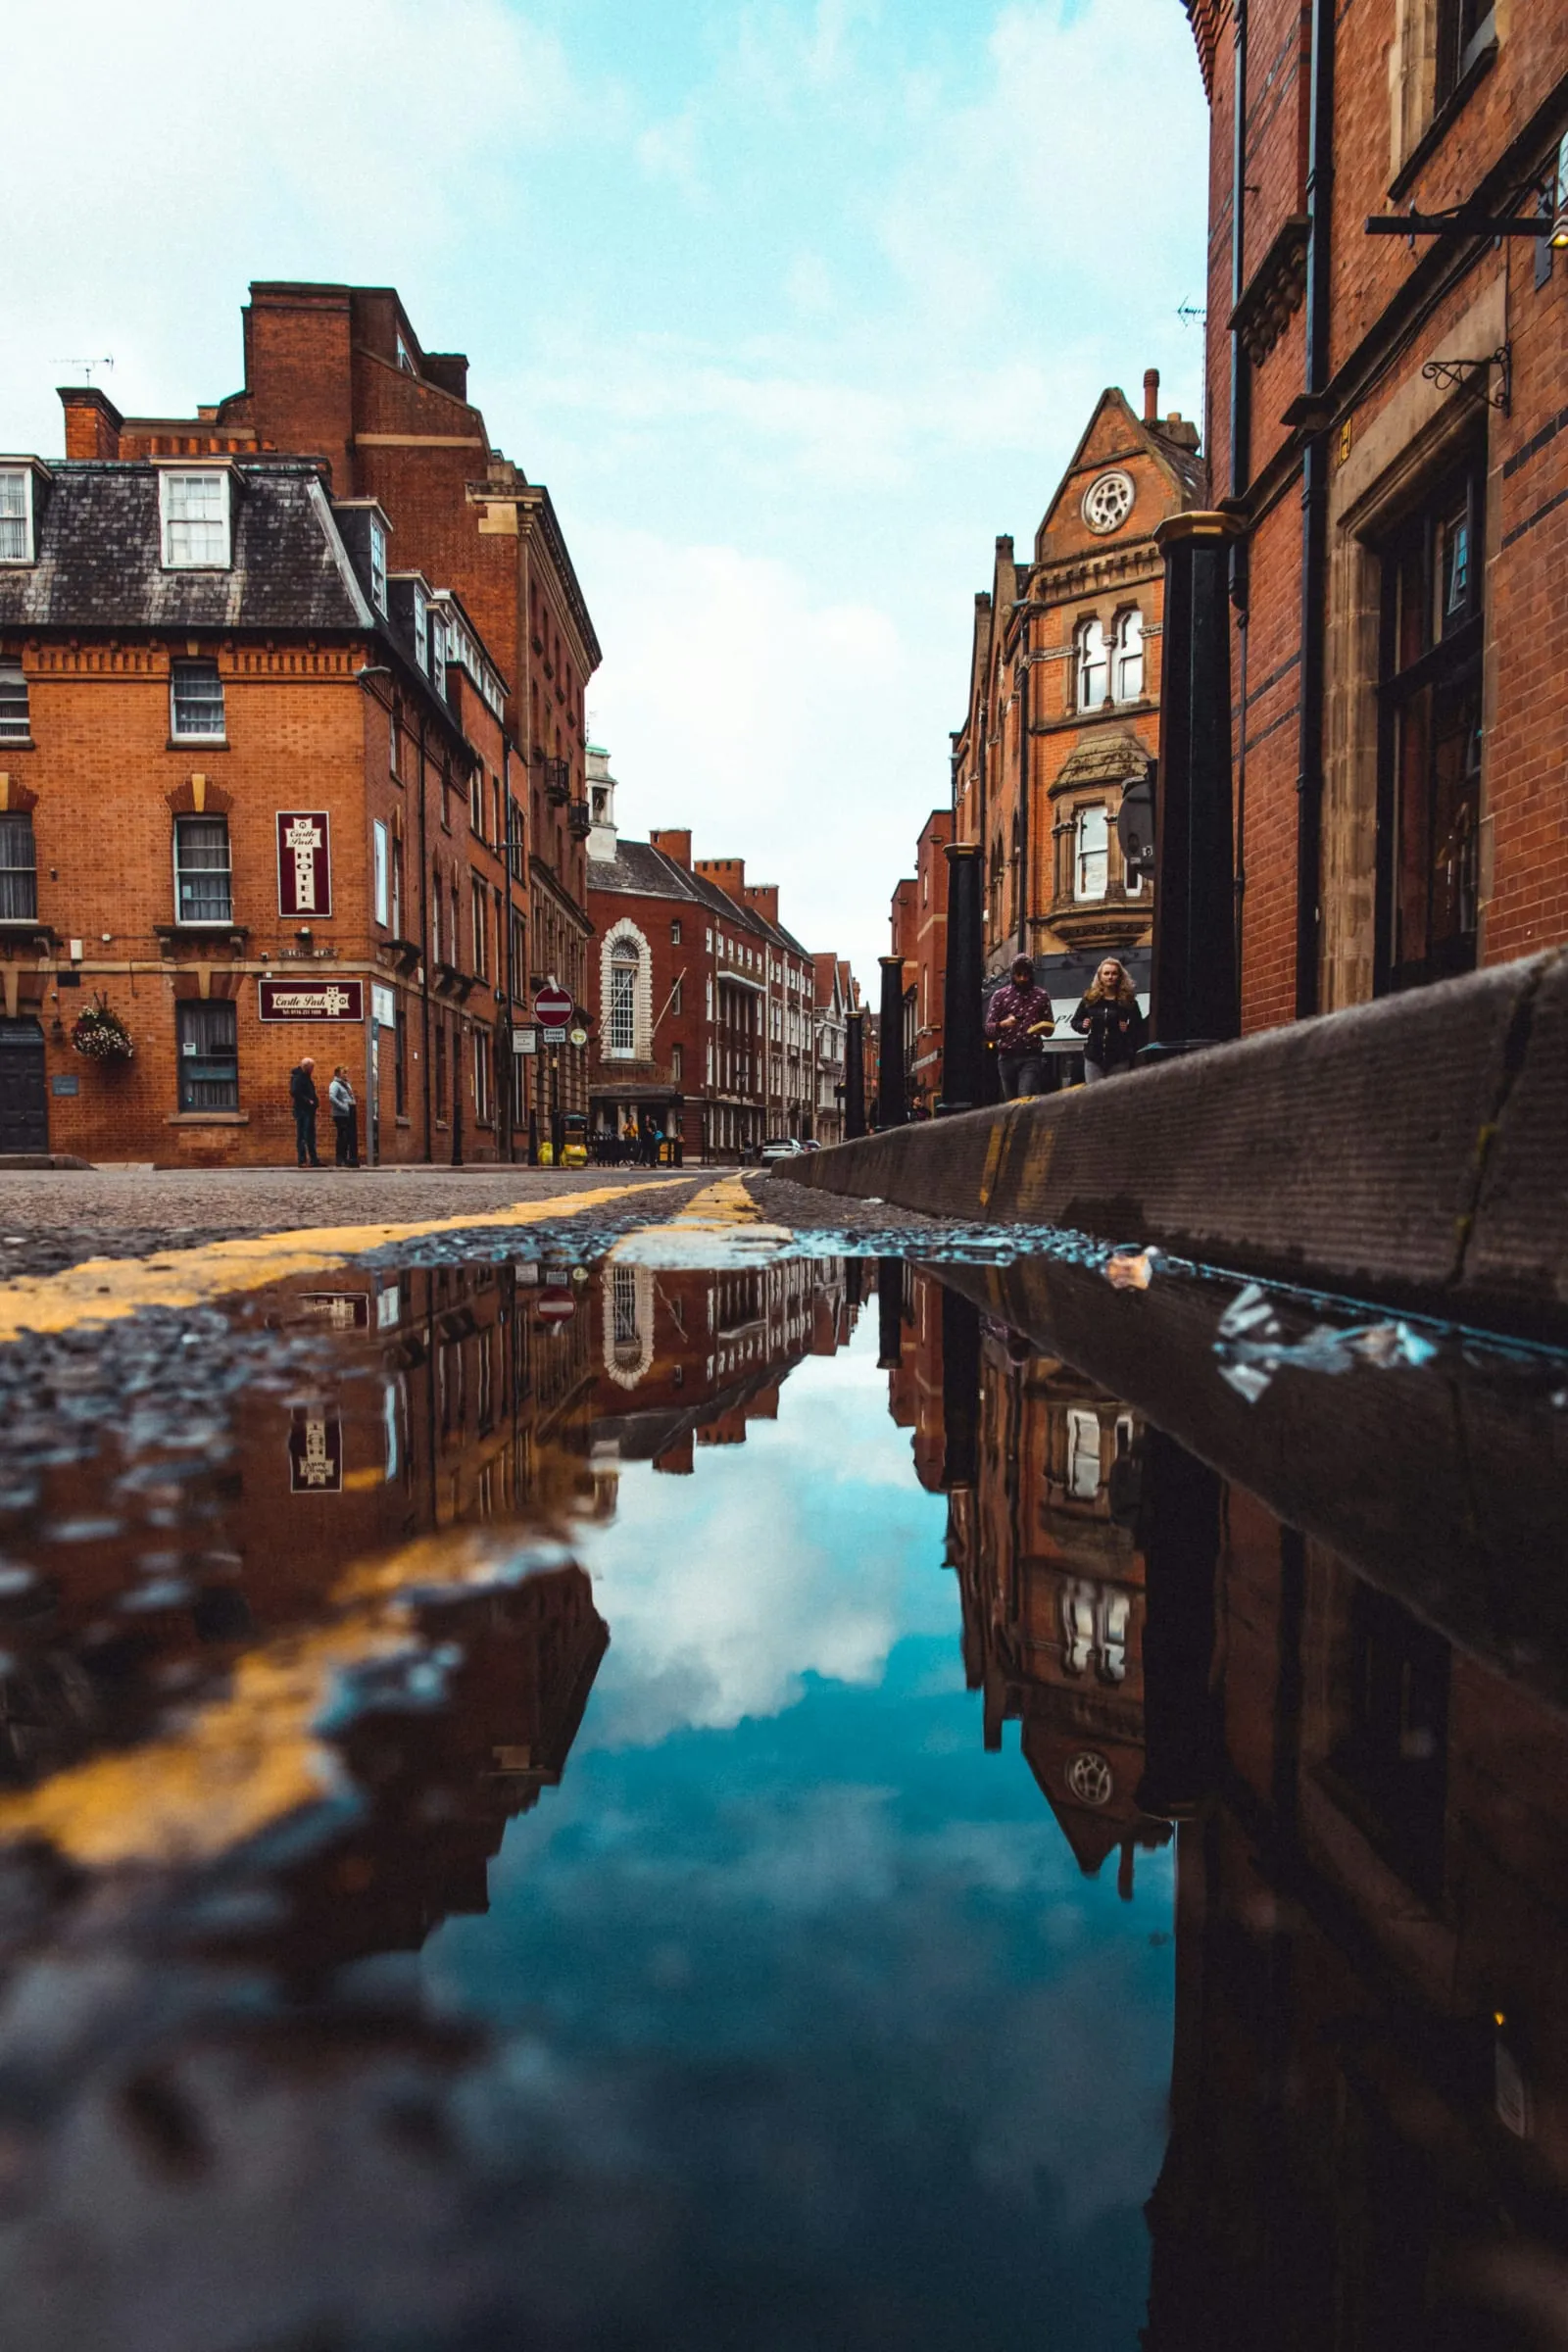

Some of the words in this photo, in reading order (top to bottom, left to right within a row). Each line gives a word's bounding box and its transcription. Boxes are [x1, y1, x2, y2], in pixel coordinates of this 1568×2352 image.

[296, 853, 313, 903] HOTEL
[275, 995, 300, 1006] Castle
[303, 995, 325, 1006] Park
